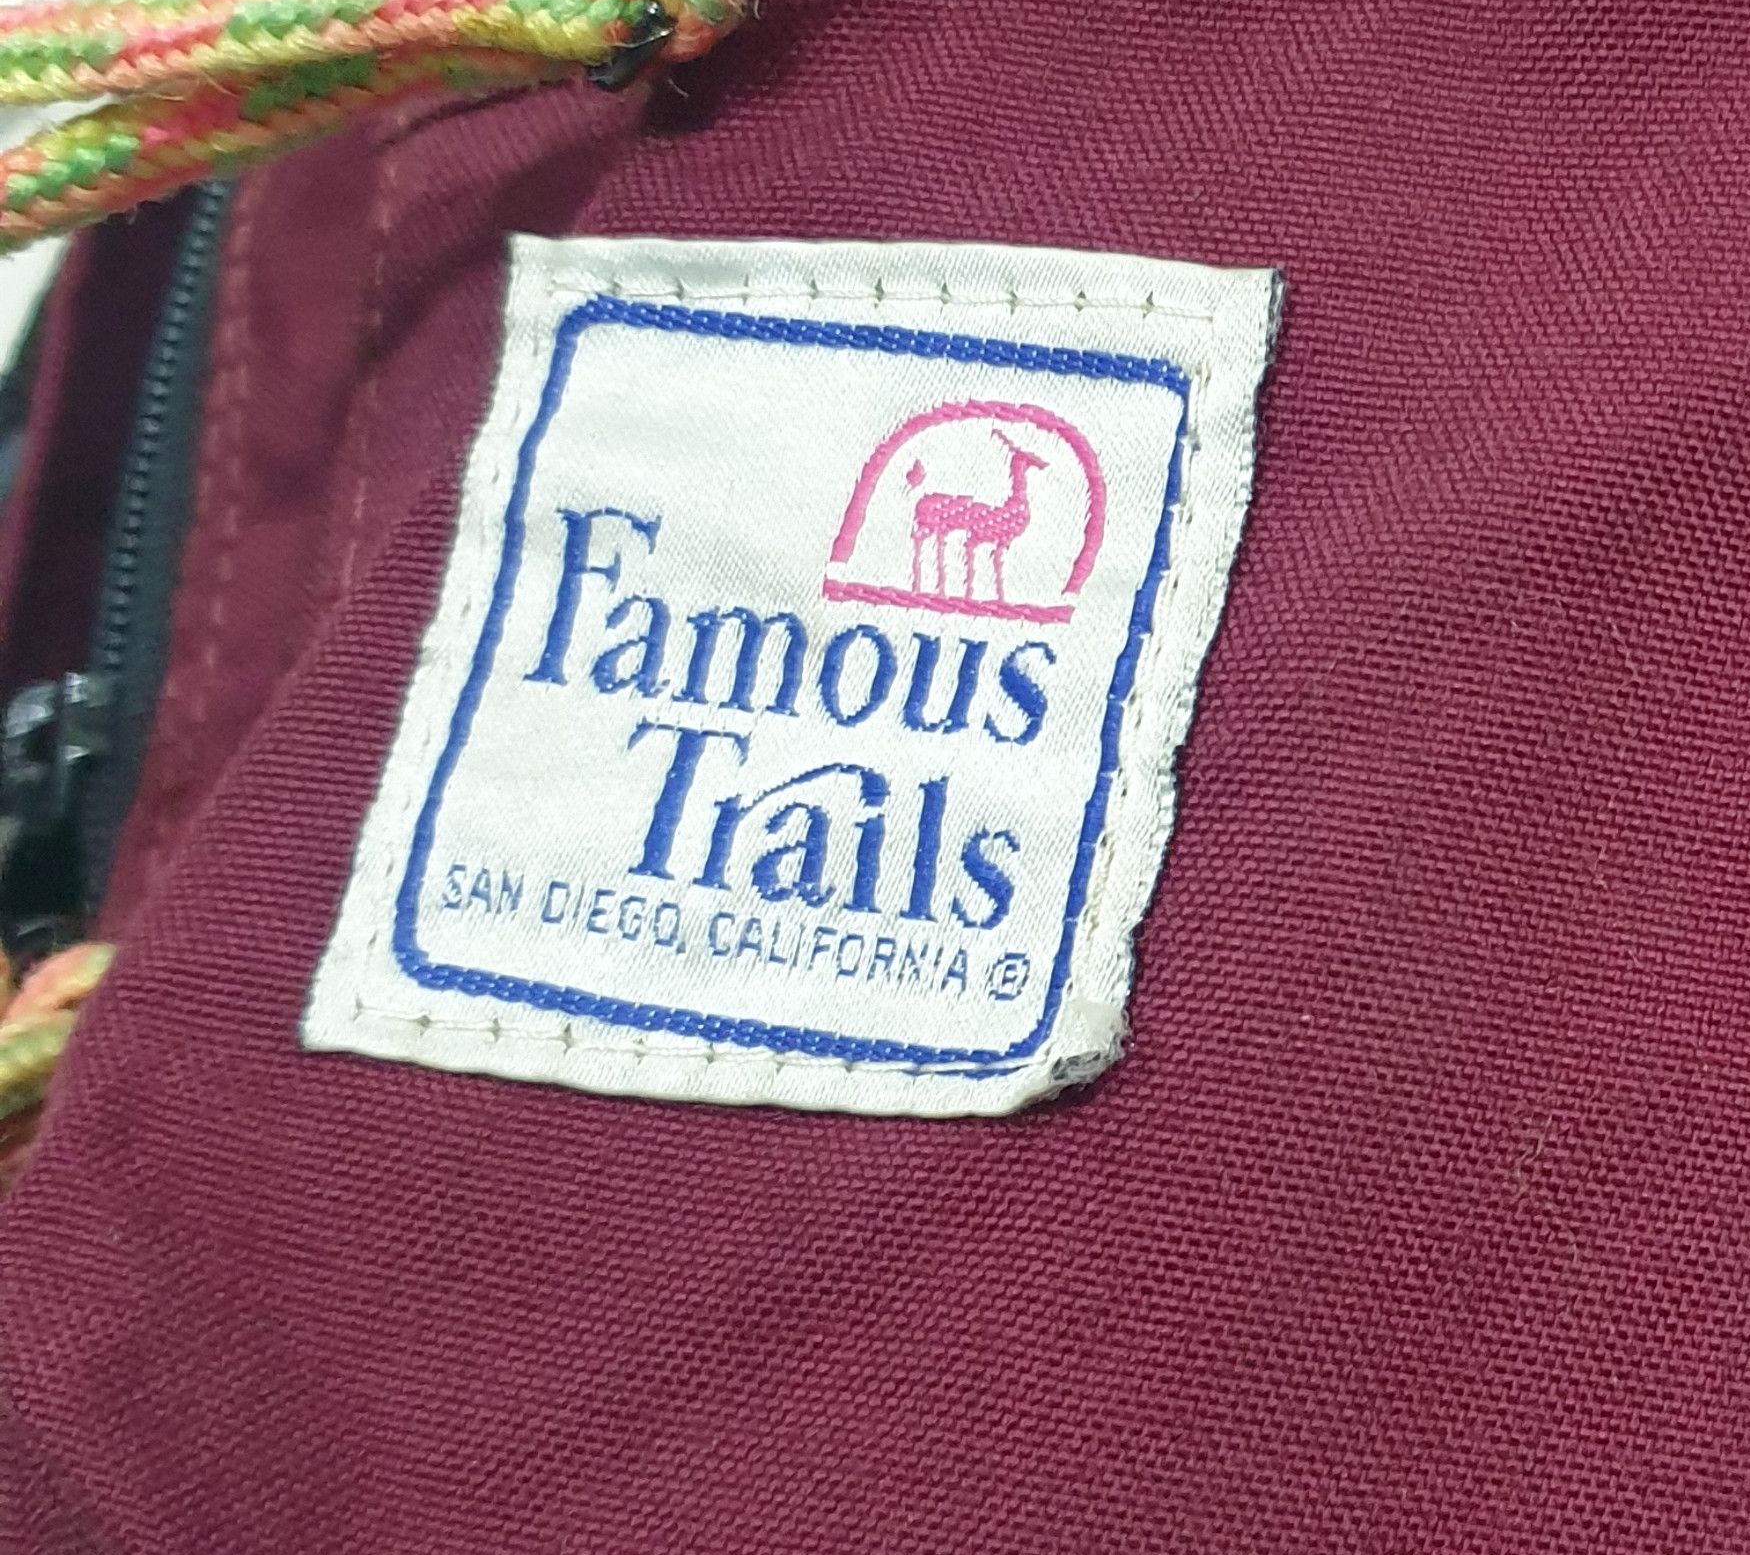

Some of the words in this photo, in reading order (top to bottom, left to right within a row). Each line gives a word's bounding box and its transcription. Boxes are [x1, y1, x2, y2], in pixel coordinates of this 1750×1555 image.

[520, 505, 1059, 747] Famous
[441, 863, 525, 914] SAN
[540, 879, 685, 953] DIEGO,
[708, 910, 970, 993] CALIFORNIA
[625, 720, 1022, 932] Trails
